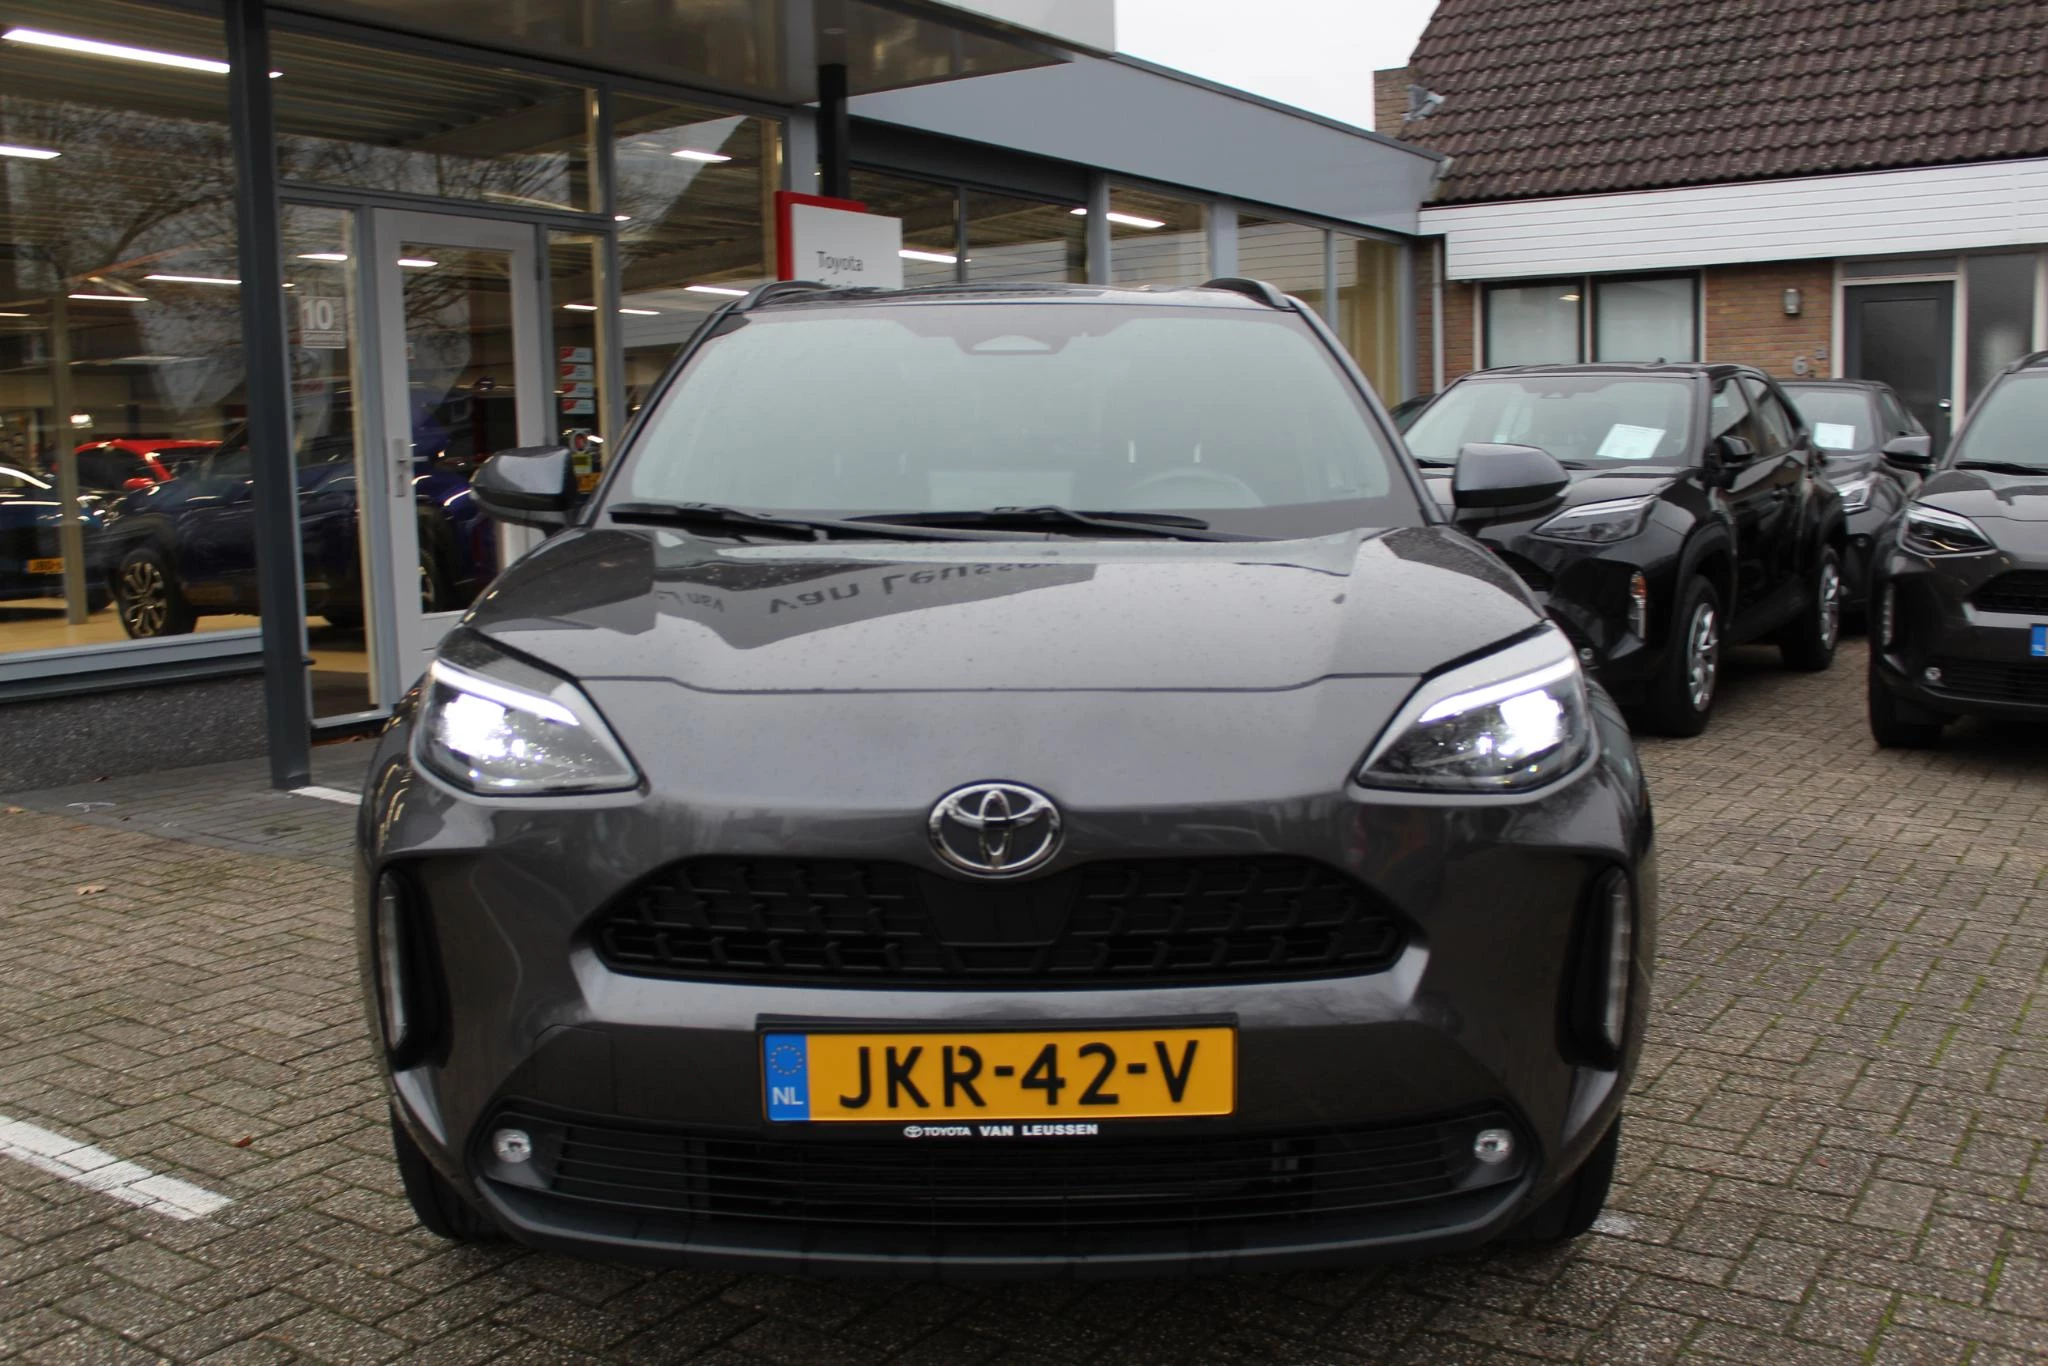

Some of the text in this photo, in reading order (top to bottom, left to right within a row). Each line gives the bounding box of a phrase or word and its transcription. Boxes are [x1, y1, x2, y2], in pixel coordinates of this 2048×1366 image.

[816, 250, 865, 275] Toyota
[303, 300, 334, 330] 10
[839, 1040, 1199, 1109] JKR-42-V
[773, 1087, 803, 1106] NL
[923, 1124, 1098, 1137] TOYOTA VAN LEUSSEN
